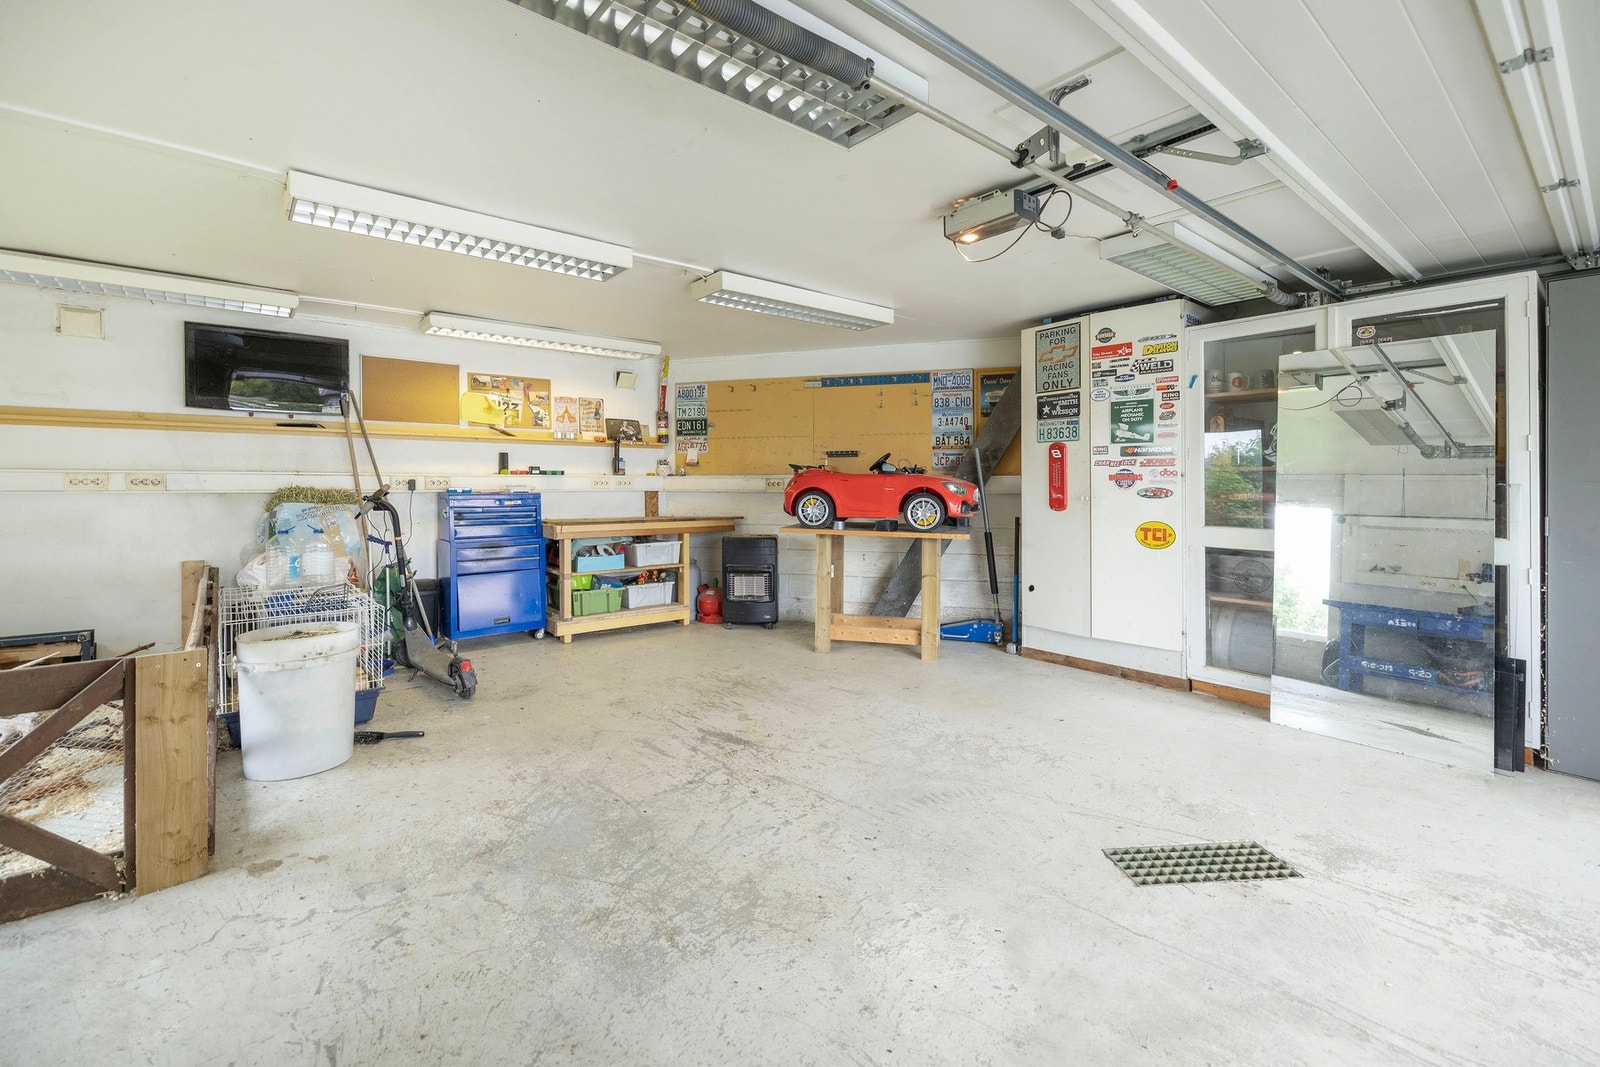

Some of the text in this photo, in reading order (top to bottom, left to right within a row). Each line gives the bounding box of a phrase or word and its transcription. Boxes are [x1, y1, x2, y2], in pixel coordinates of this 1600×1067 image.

[1040, 327, 1076, 340] PARKING
[1049, 337, 1066, 346] FOR
[1042, 361, 1074, 373] RACING
[1140, 361, 1173, 370] WELD
[1047, 370, 1069, 380] FANS
[1042, 378, 1074, 391] ONLY
[1051, 407, 1079, 416] WESSON
[935, 436, 951, 446] BAT
[934, 456, 949, 466] JCP
[1159, 468, 1178, 476] dba
